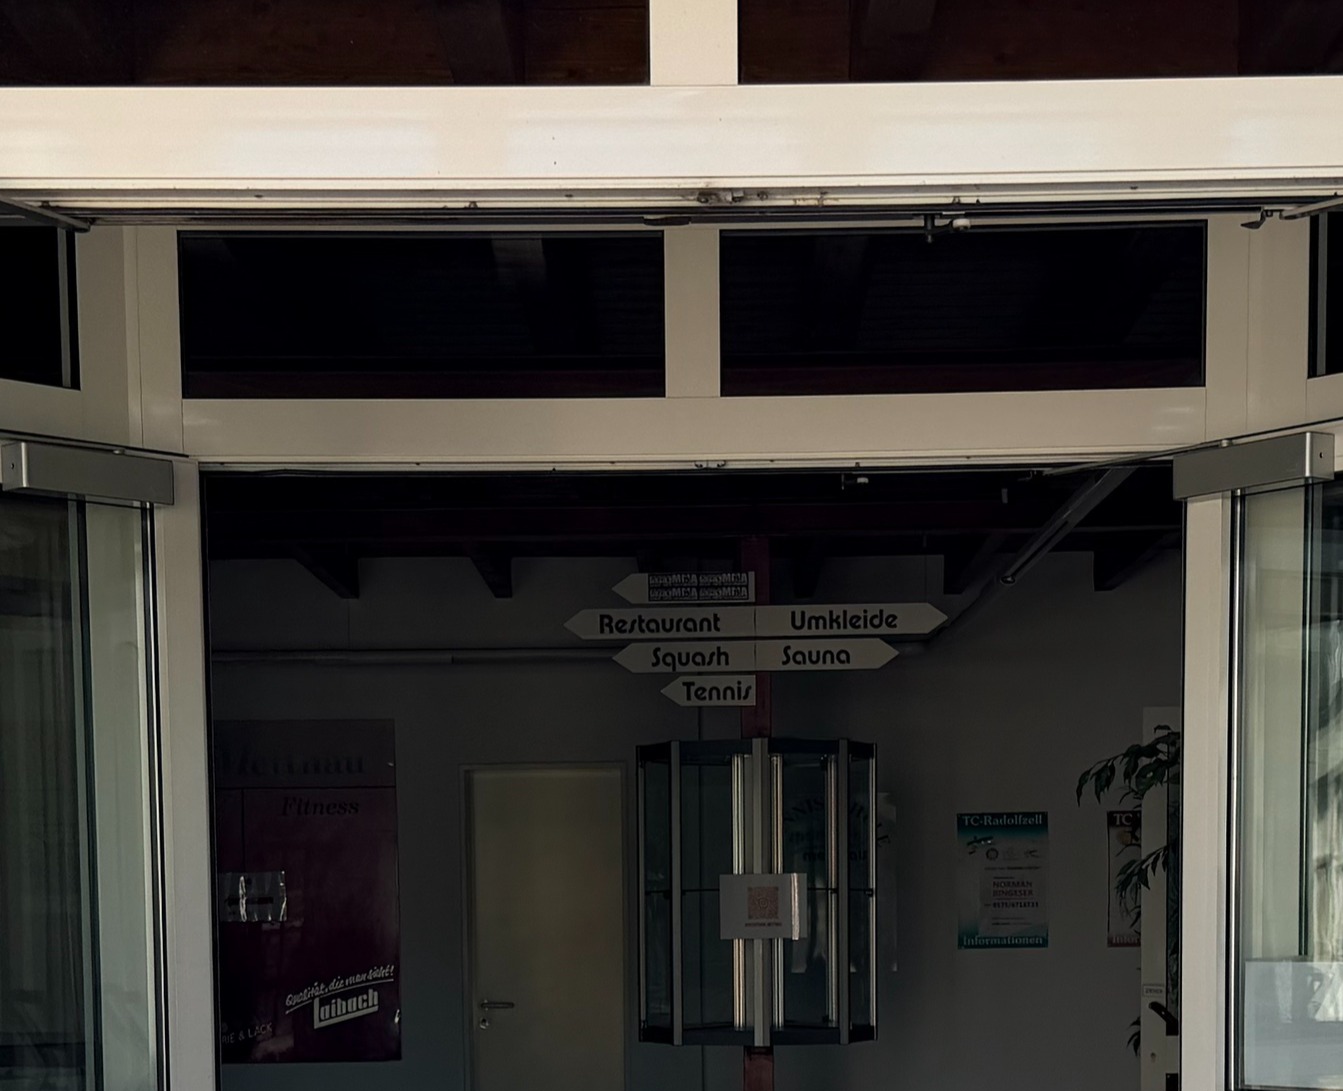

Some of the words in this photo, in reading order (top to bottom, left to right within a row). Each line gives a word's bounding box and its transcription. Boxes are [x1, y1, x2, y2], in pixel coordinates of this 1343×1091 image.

[598, 613, 722, 634] Restaurant
[790, 608, 898, 632] Umkleide
[651, 645, 730, 672] Squash
[781, 645, 851, 666] Sauna
[682, 680, 752, 702] Tennis
[281, 796, 360, 817] Fitness
[962, 935, 1044, 946] Informationen
[313, 988, 379, 1029] Laibach
